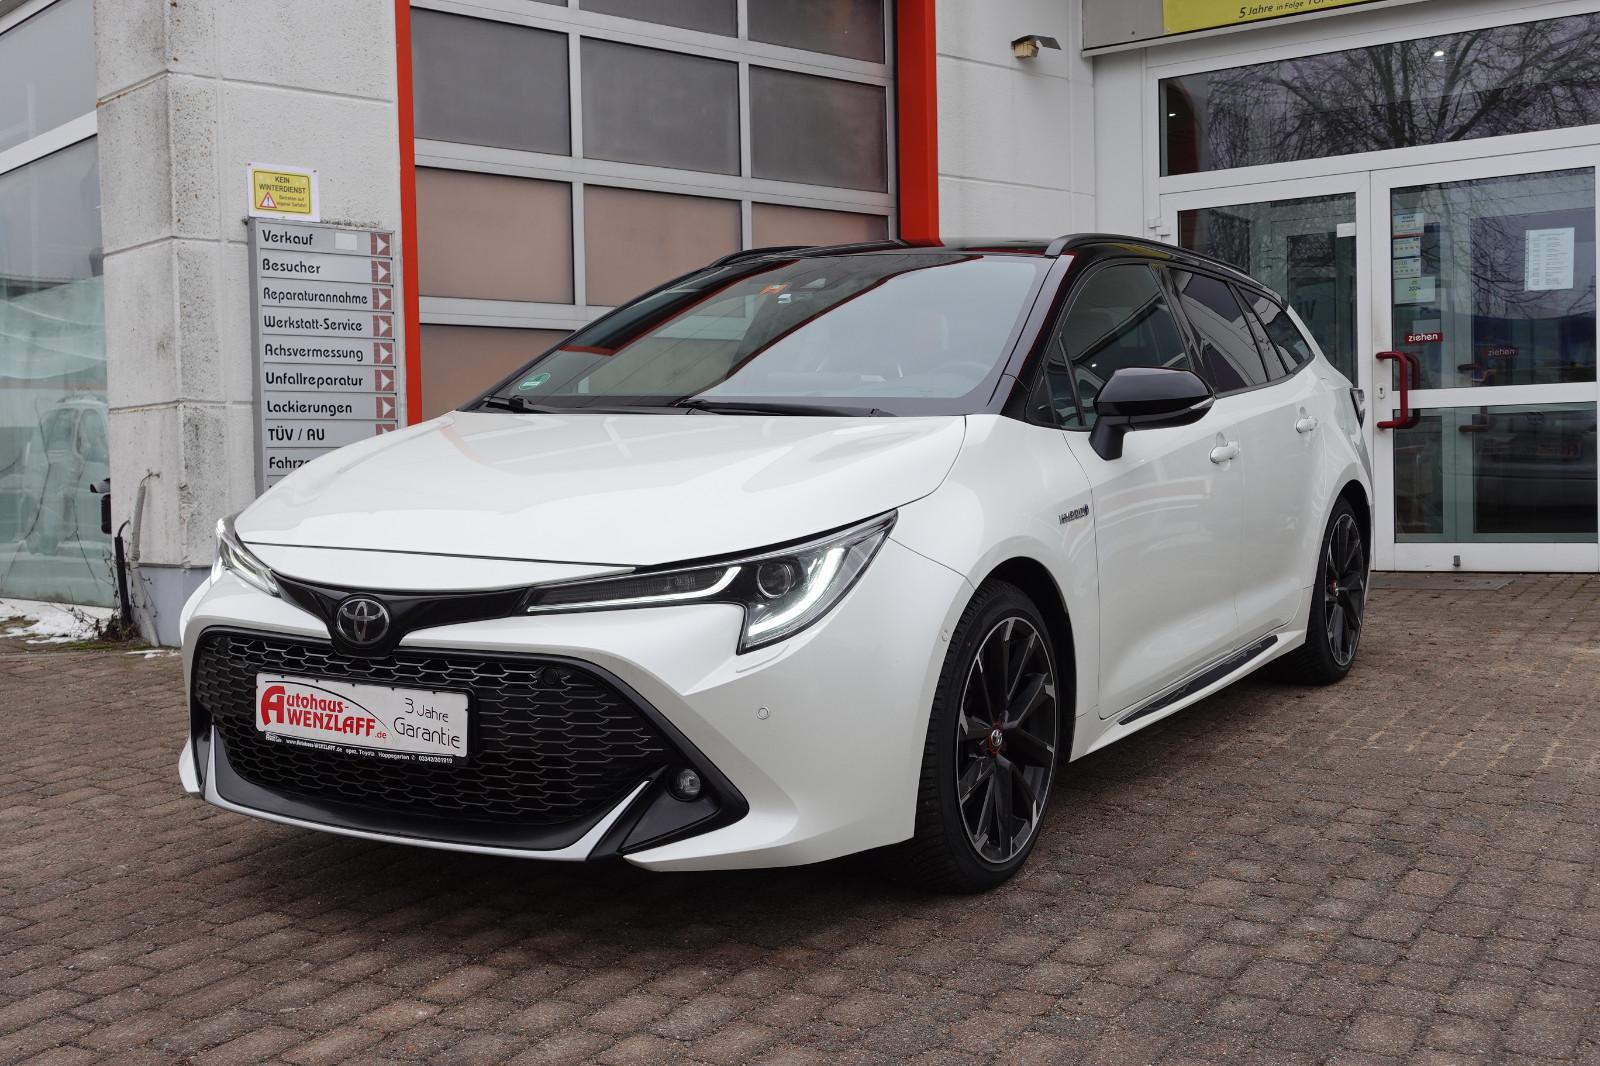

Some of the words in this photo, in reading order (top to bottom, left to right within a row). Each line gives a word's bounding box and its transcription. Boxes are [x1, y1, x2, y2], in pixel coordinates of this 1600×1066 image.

[1239, 7, 1247, 18] 5
[1247, 4, 1274, 16] Jahre
[1284, 2, 1304, 10] Folge
[259, 183, 306, 194] WINTERDIENST
[274, 176, 290, 184] KEIN
[262, 229, 313, 246] Verkauf
[262, 258, 321, 274] Besucher
[263, 287, 368, 304] Reparaturannahme
[264, 315, 363, 332] Werkstatt-Service
[1408, 332, 1438, 342] ziehen
[264, 344, 364, 362] Achsvermessung
[265, 372, 364, 389] Unfallreparatur
[267, 400, 353, 417] Lackierungen
[267, 425, 294, 441] TÜV
[297, 428, 303, 441] /
[307, 428, 325, 441] AU
[269, 456, 311, 469] Fahrz
[404, 697, 415, 714] 3
[416, 704, 449, 723] Jahre
[393, 717, 461, 749] Garantie
